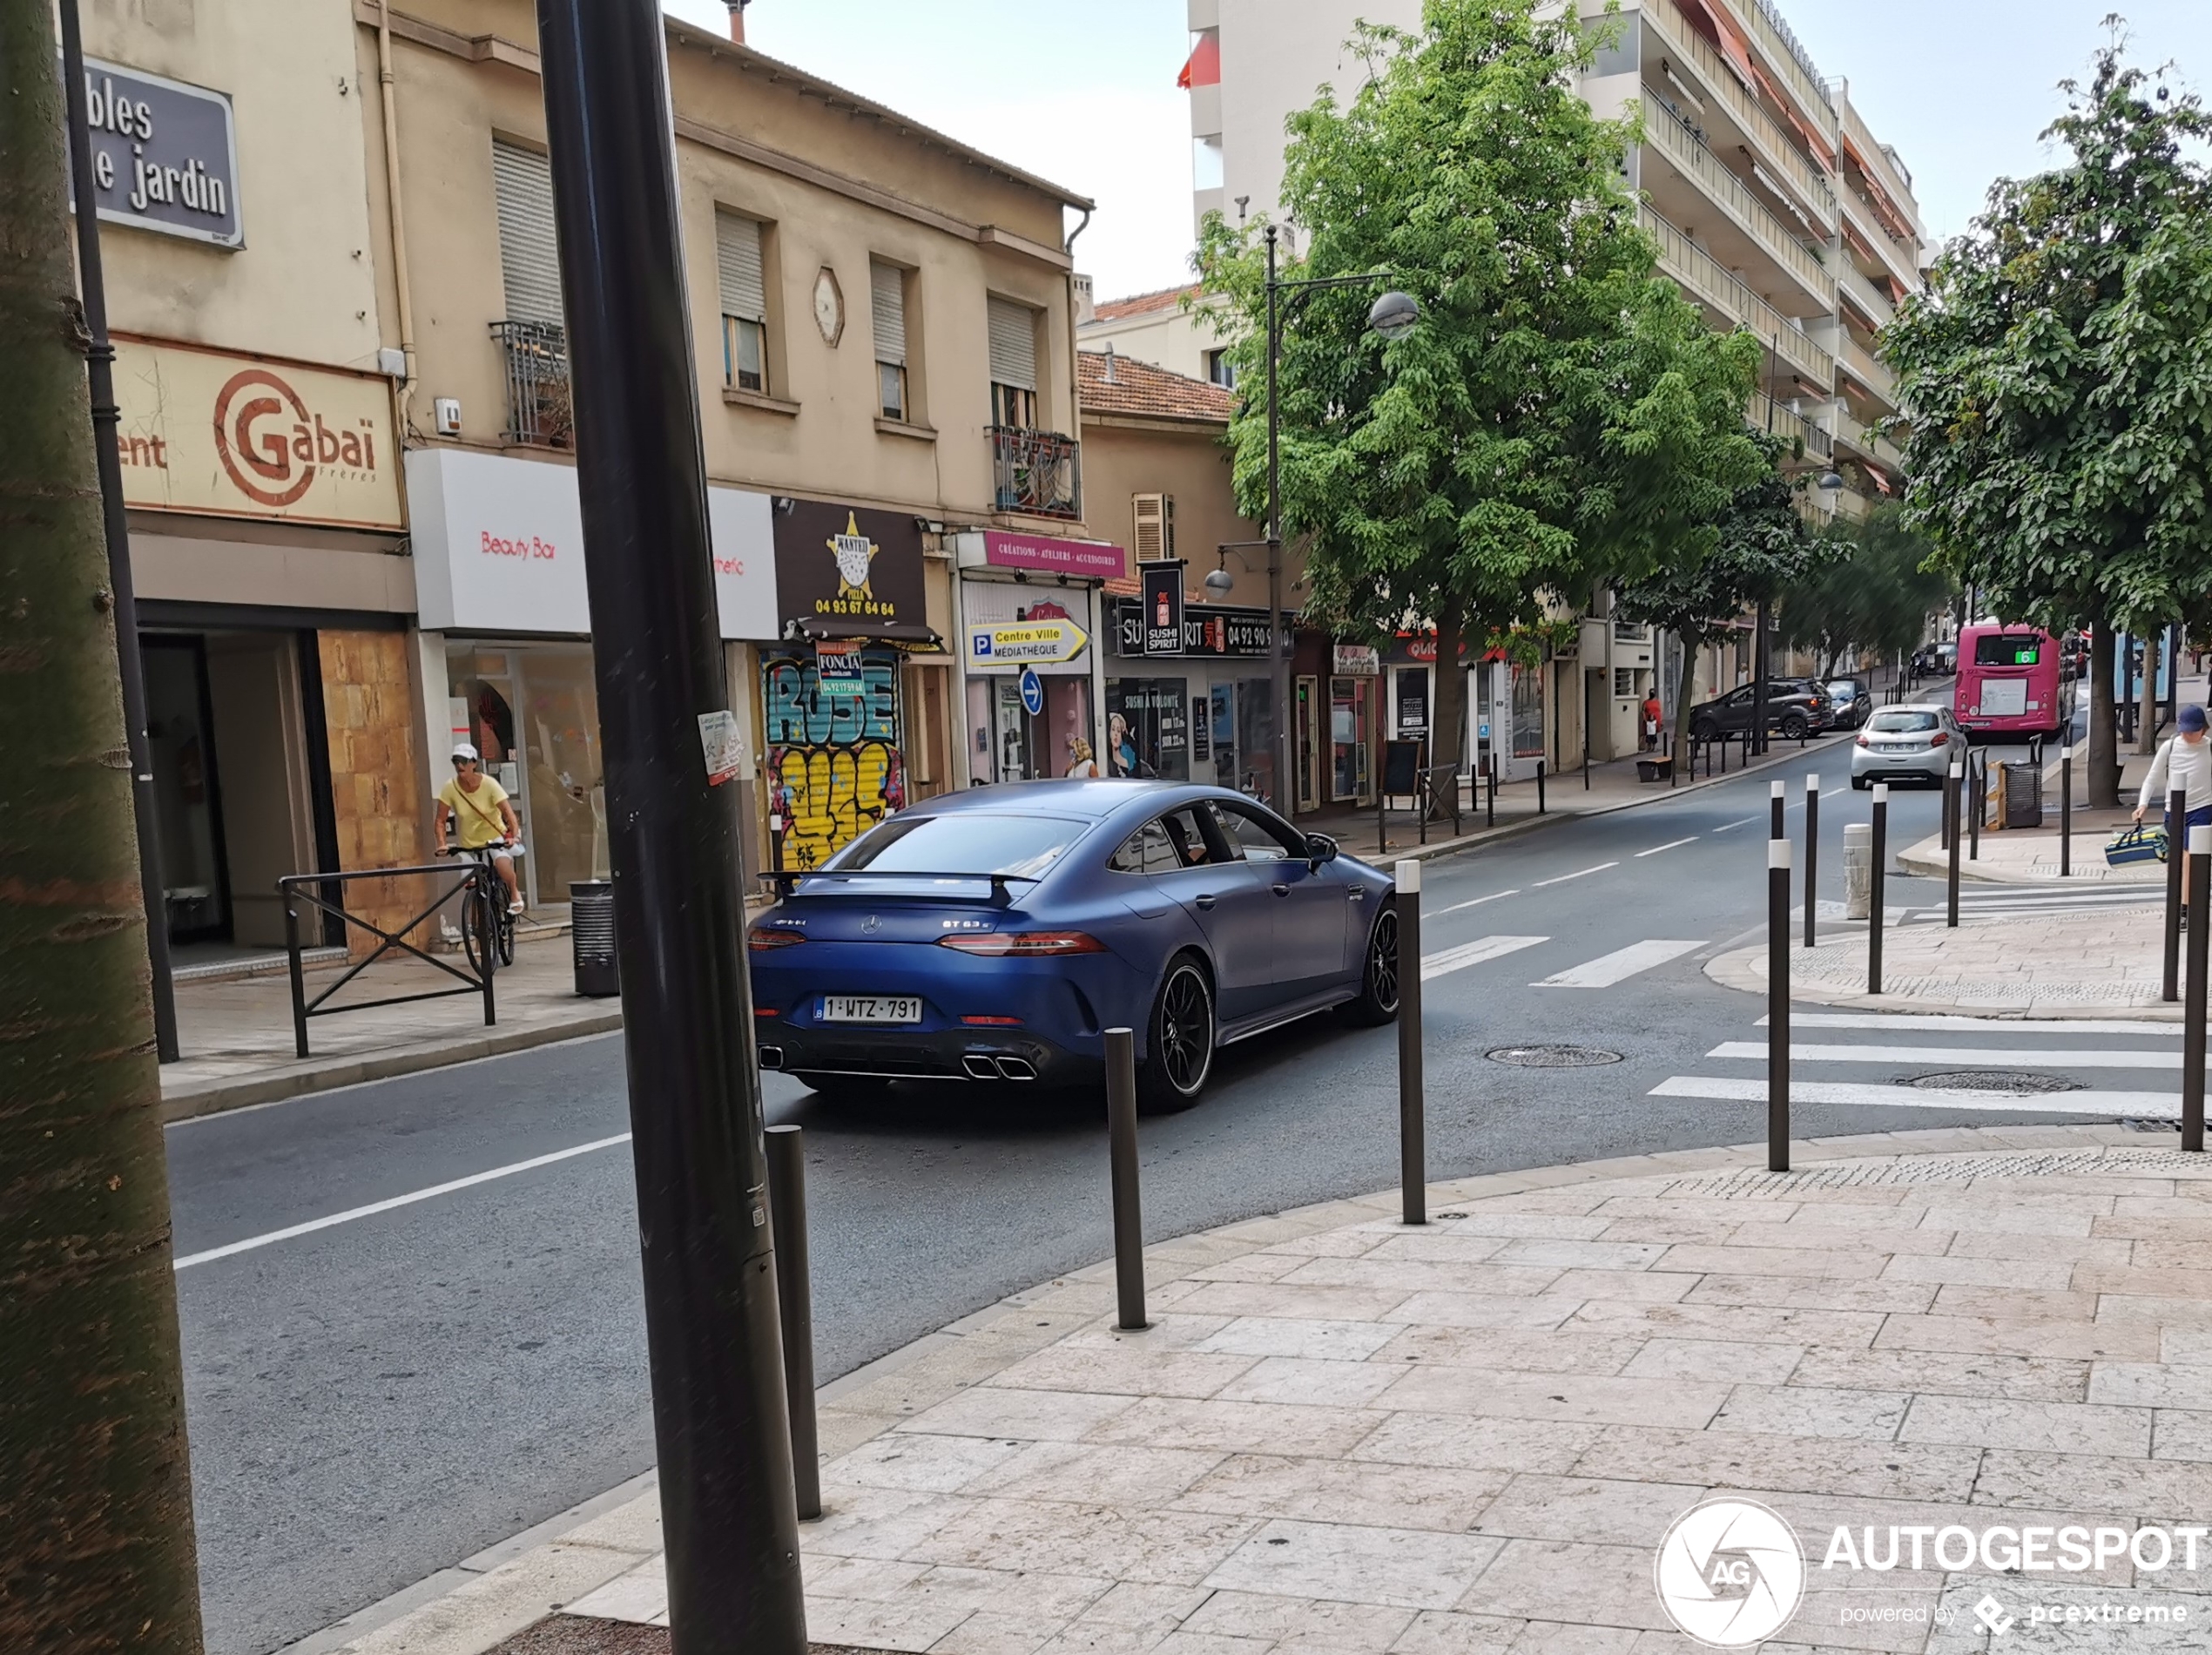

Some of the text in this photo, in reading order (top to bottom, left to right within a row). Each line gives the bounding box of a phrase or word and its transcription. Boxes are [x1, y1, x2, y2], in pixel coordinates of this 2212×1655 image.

[93, 143, 226, 216] e jardin
[235, 397, 375, 481] Gabaï
[319, 466, 377, 483] Frères
[482, 530, 529, 560] Beauty
[837, 537, 868, 553] WANTED
[998, 544, 1116, 566] CRÉATIONS ATELIERS ACCESSOIRES
[816, 599, 894, 616] 04 93 67 64 64
[995, 629, 1060, 642] Centre Ville
[1149, 628, 1177, 639] SUSHI
[1228, 625, 1239, 645] 04
[1241, 625, 1252, 645] 92
[1254, 627, 1265, 645] 90
[976, 637, 988, 654] P
[994, 645, 1058, 658] MÉDIATHÈQUE
[1149, 638, 1179, 650] SPIRIT
[819, 654, 860, 670] FONCIA
[2020, 651, 2031, 664] 6
[1125, 695, 1143, 709] SUSHI
[1151, 692, 1179, 708] VOLONTÉ
